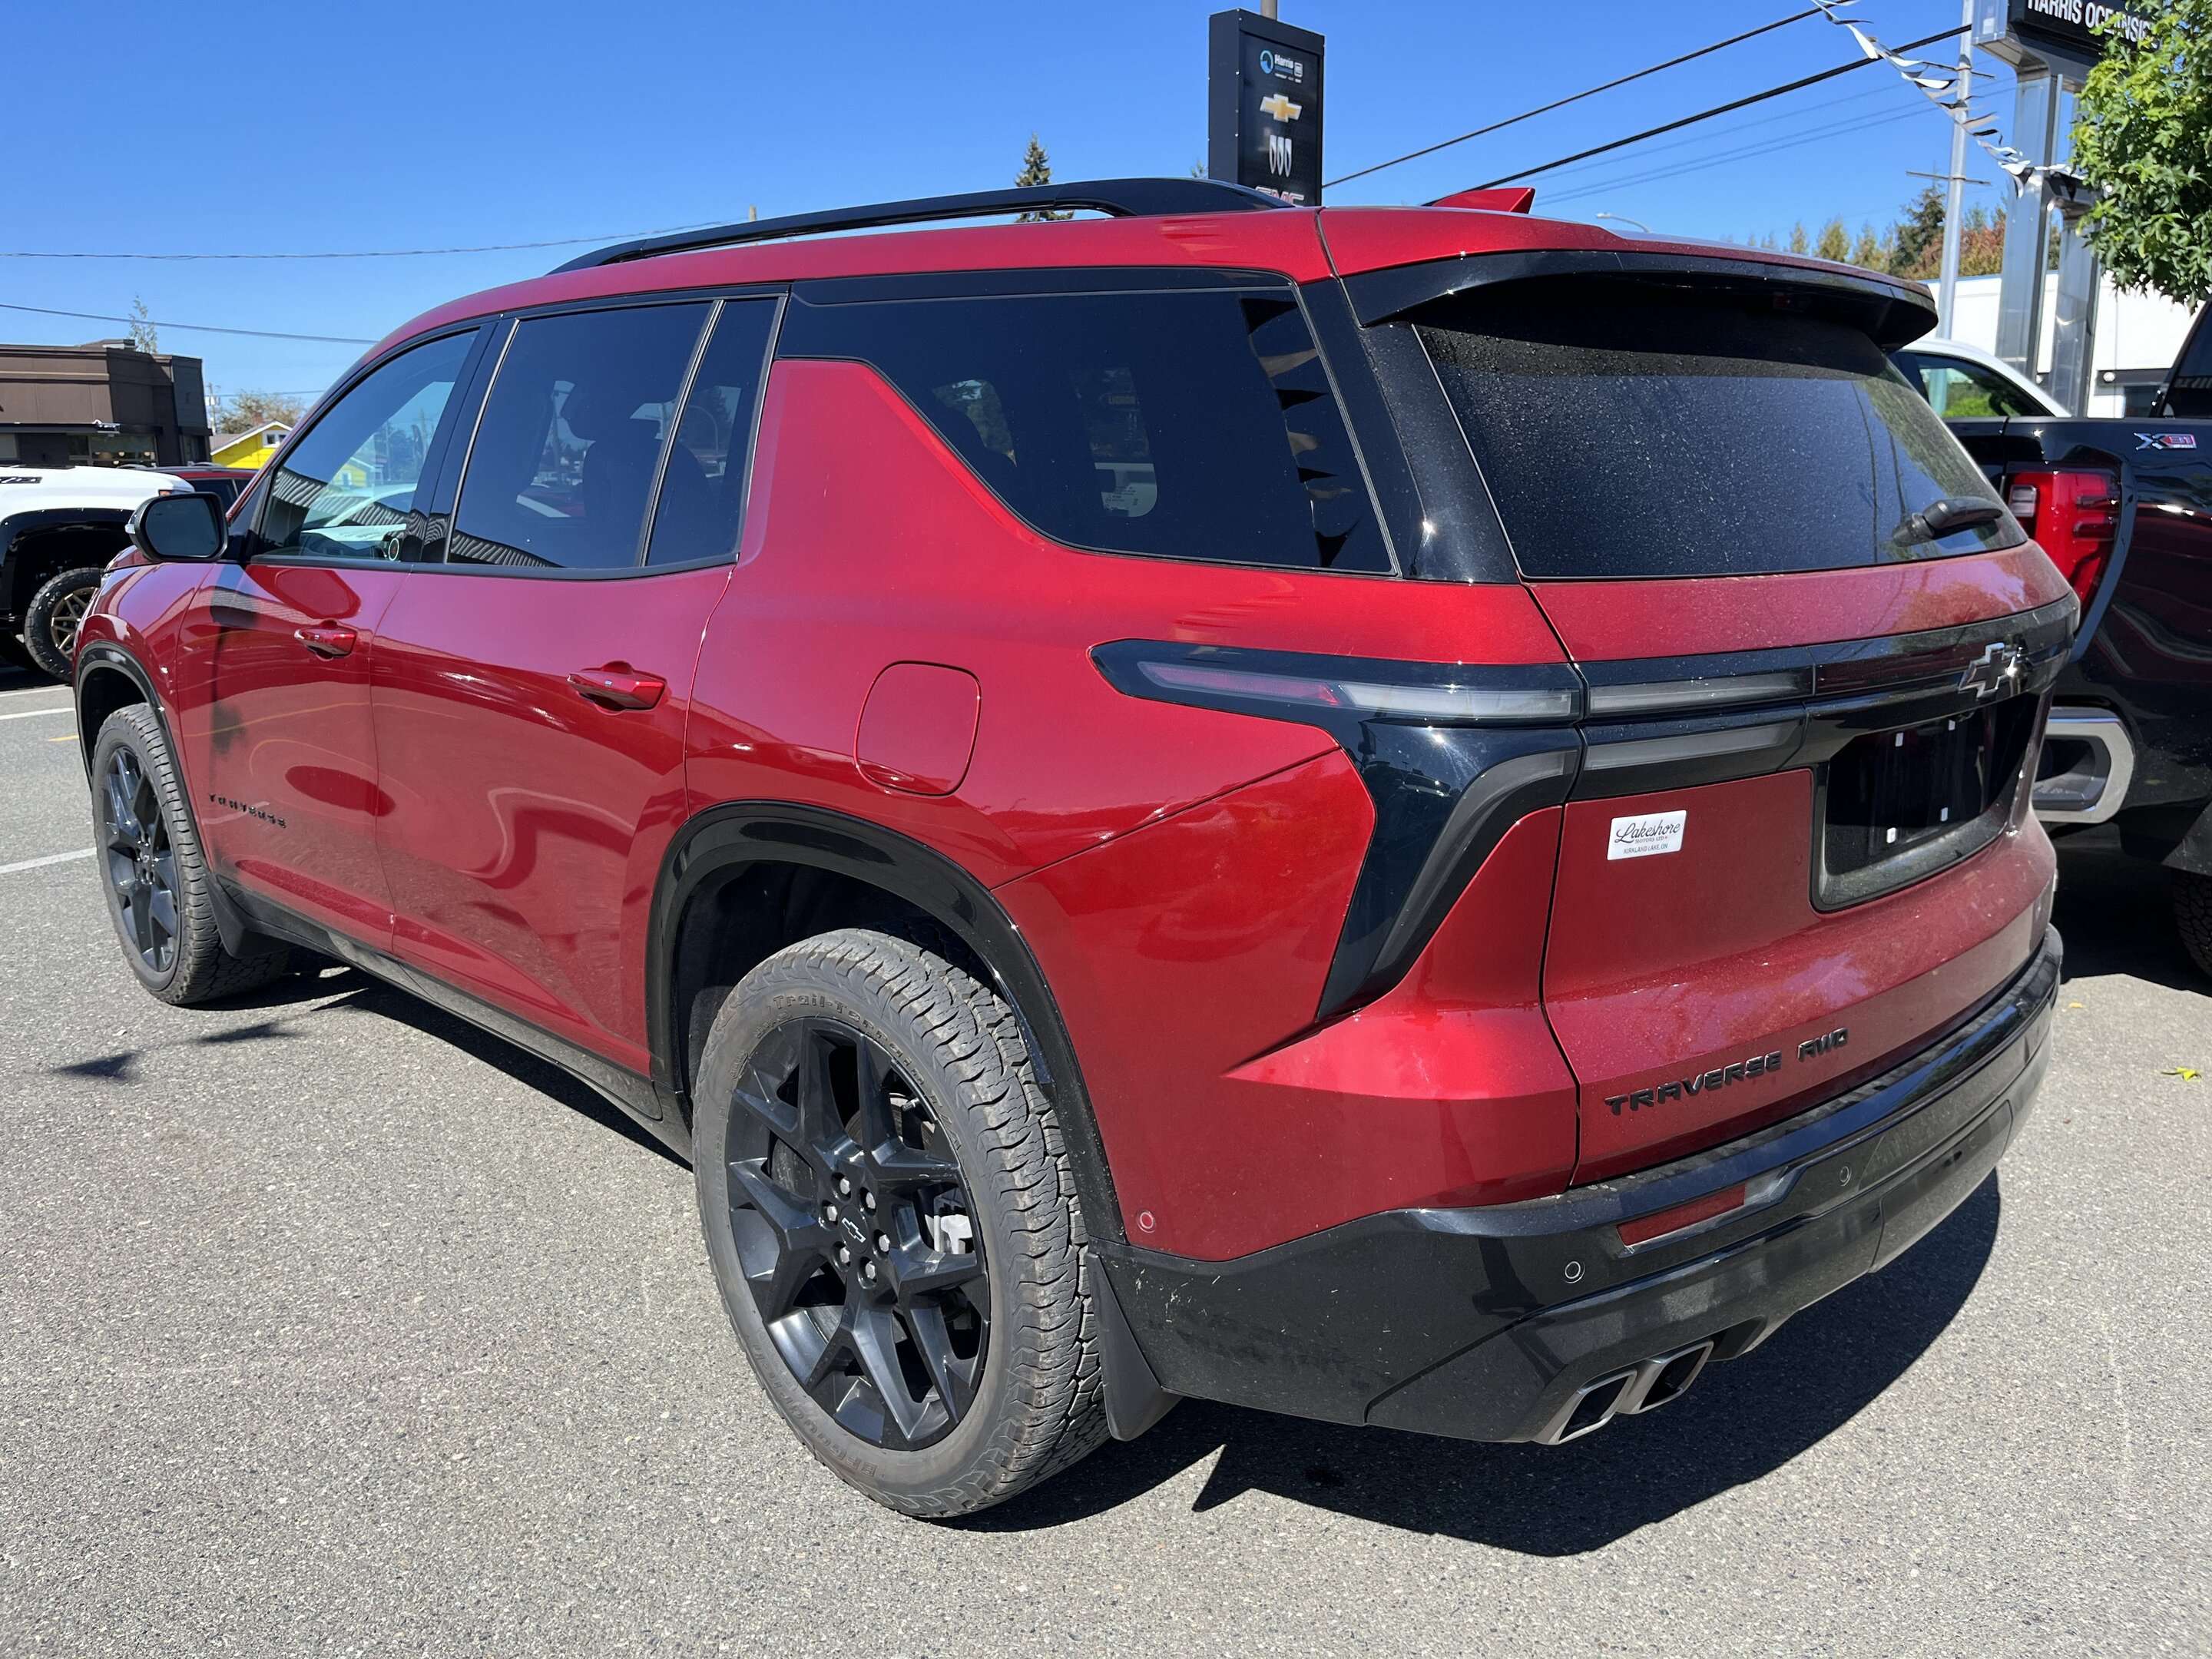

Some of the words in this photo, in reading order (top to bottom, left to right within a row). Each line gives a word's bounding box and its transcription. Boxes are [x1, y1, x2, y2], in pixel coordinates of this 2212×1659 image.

[1614, 820, 1681, 844] Lakeshore
[1604, 1050, 1783, 1116] TRAVERSE
[1797, 1027, 1849, 1062] AWD
